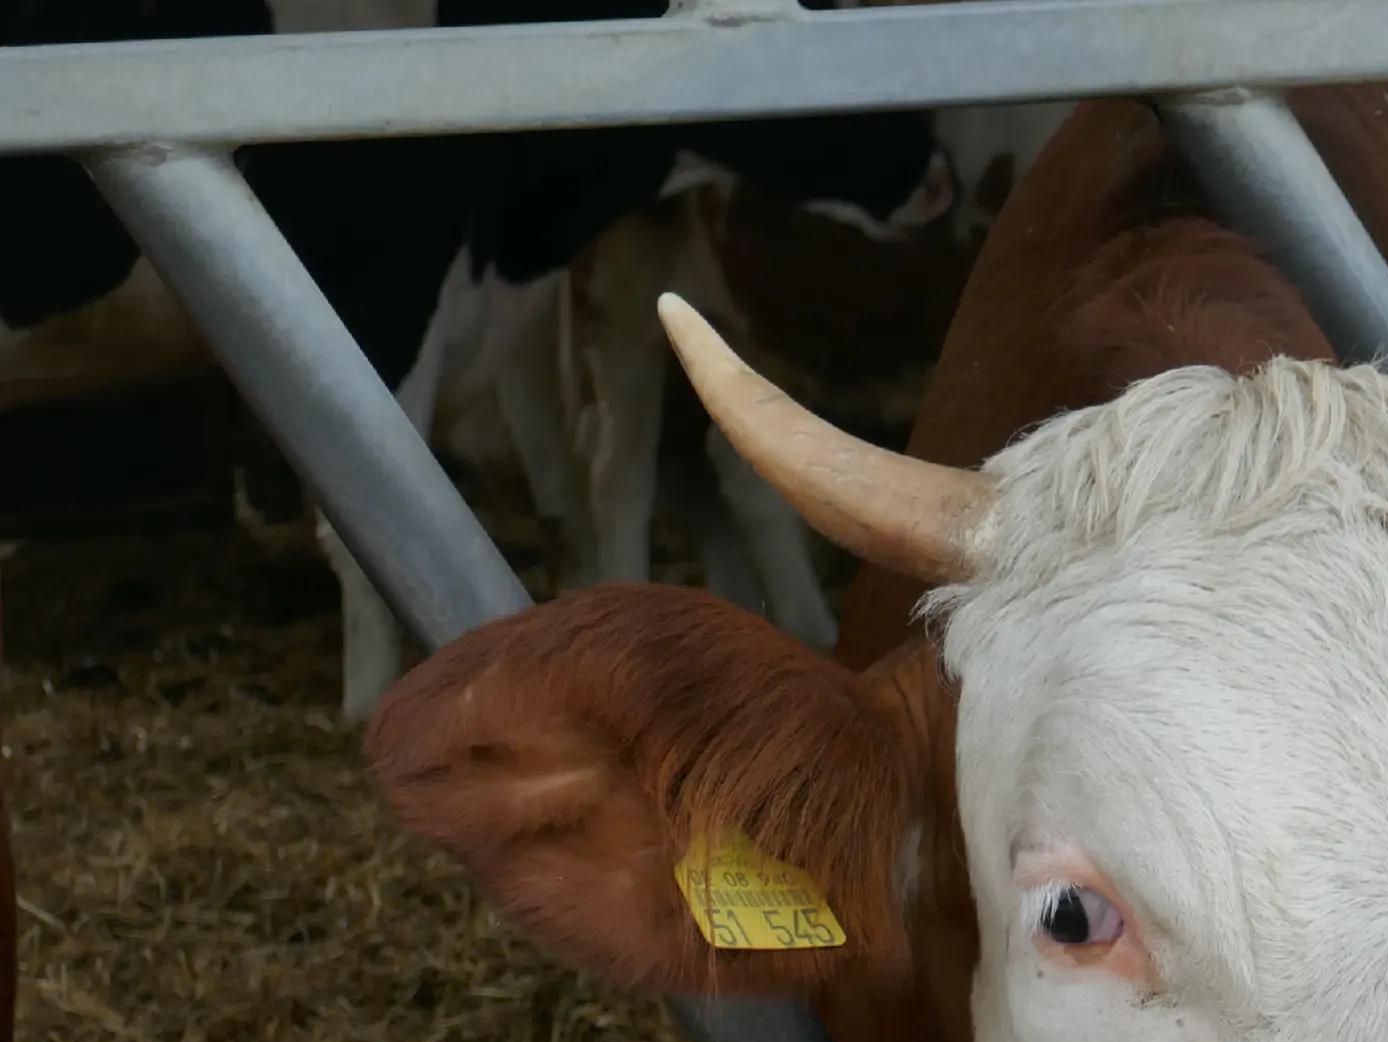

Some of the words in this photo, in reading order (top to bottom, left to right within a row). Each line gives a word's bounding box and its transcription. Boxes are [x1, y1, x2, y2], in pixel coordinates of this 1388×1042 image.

[723, 872, 749, 887] 08
[705, 909, 752, 945] 51
[762, 908, 835, 946] 545
